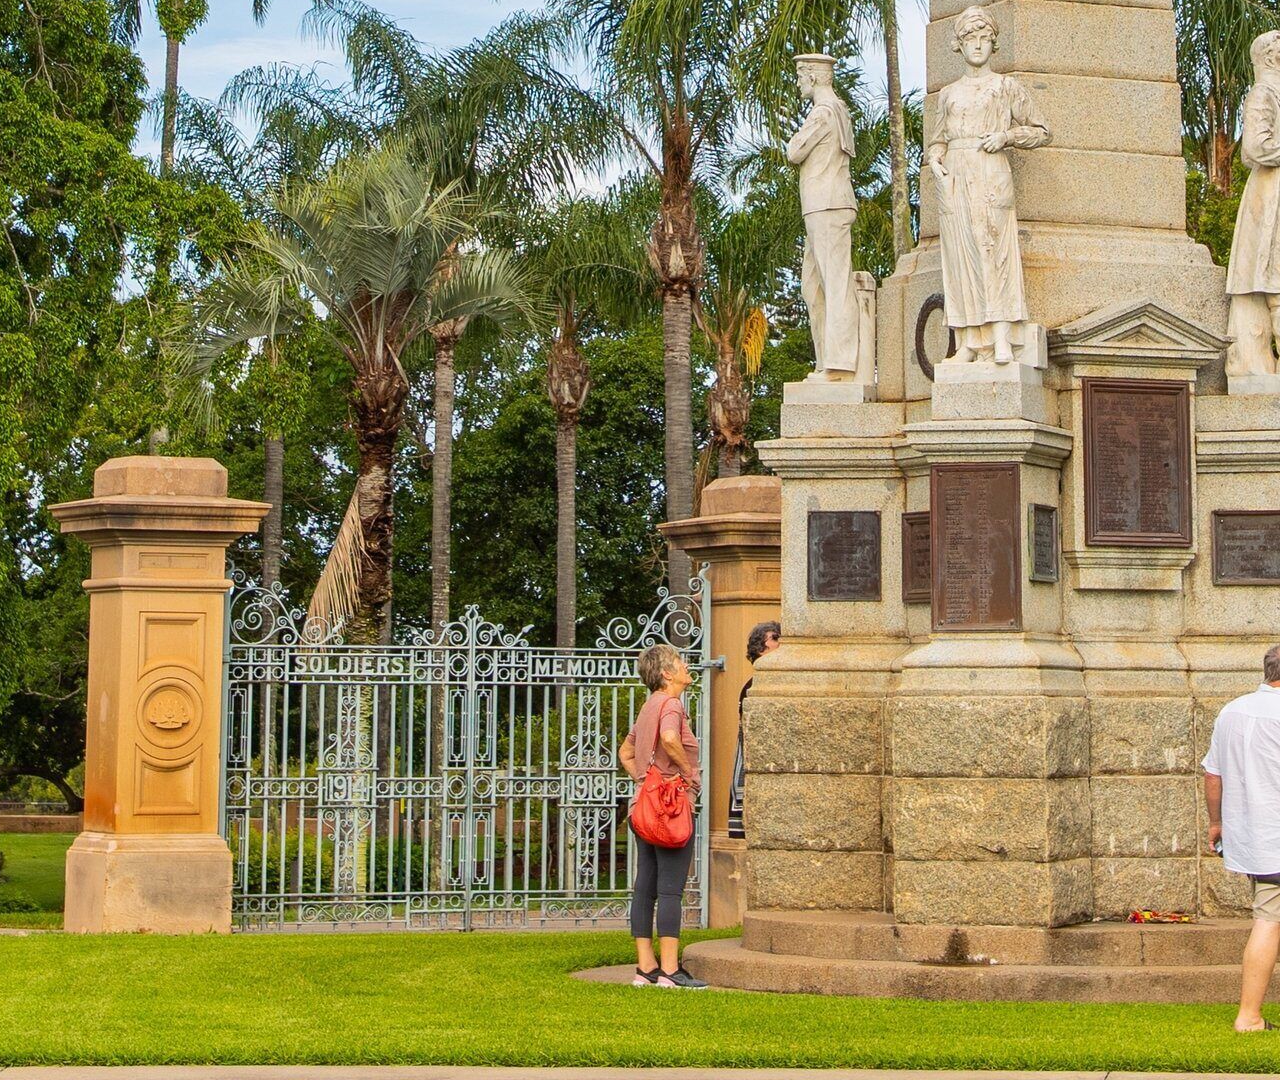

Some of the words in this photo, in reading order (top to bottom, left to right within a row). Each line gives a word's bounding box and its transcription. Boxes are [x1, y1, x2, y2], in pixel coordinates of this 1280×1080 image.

[294, 656, 404, 674] SOLDIERS
[328, 775, 367, 800] 1914
[569, 775, 607, 800] 1918
